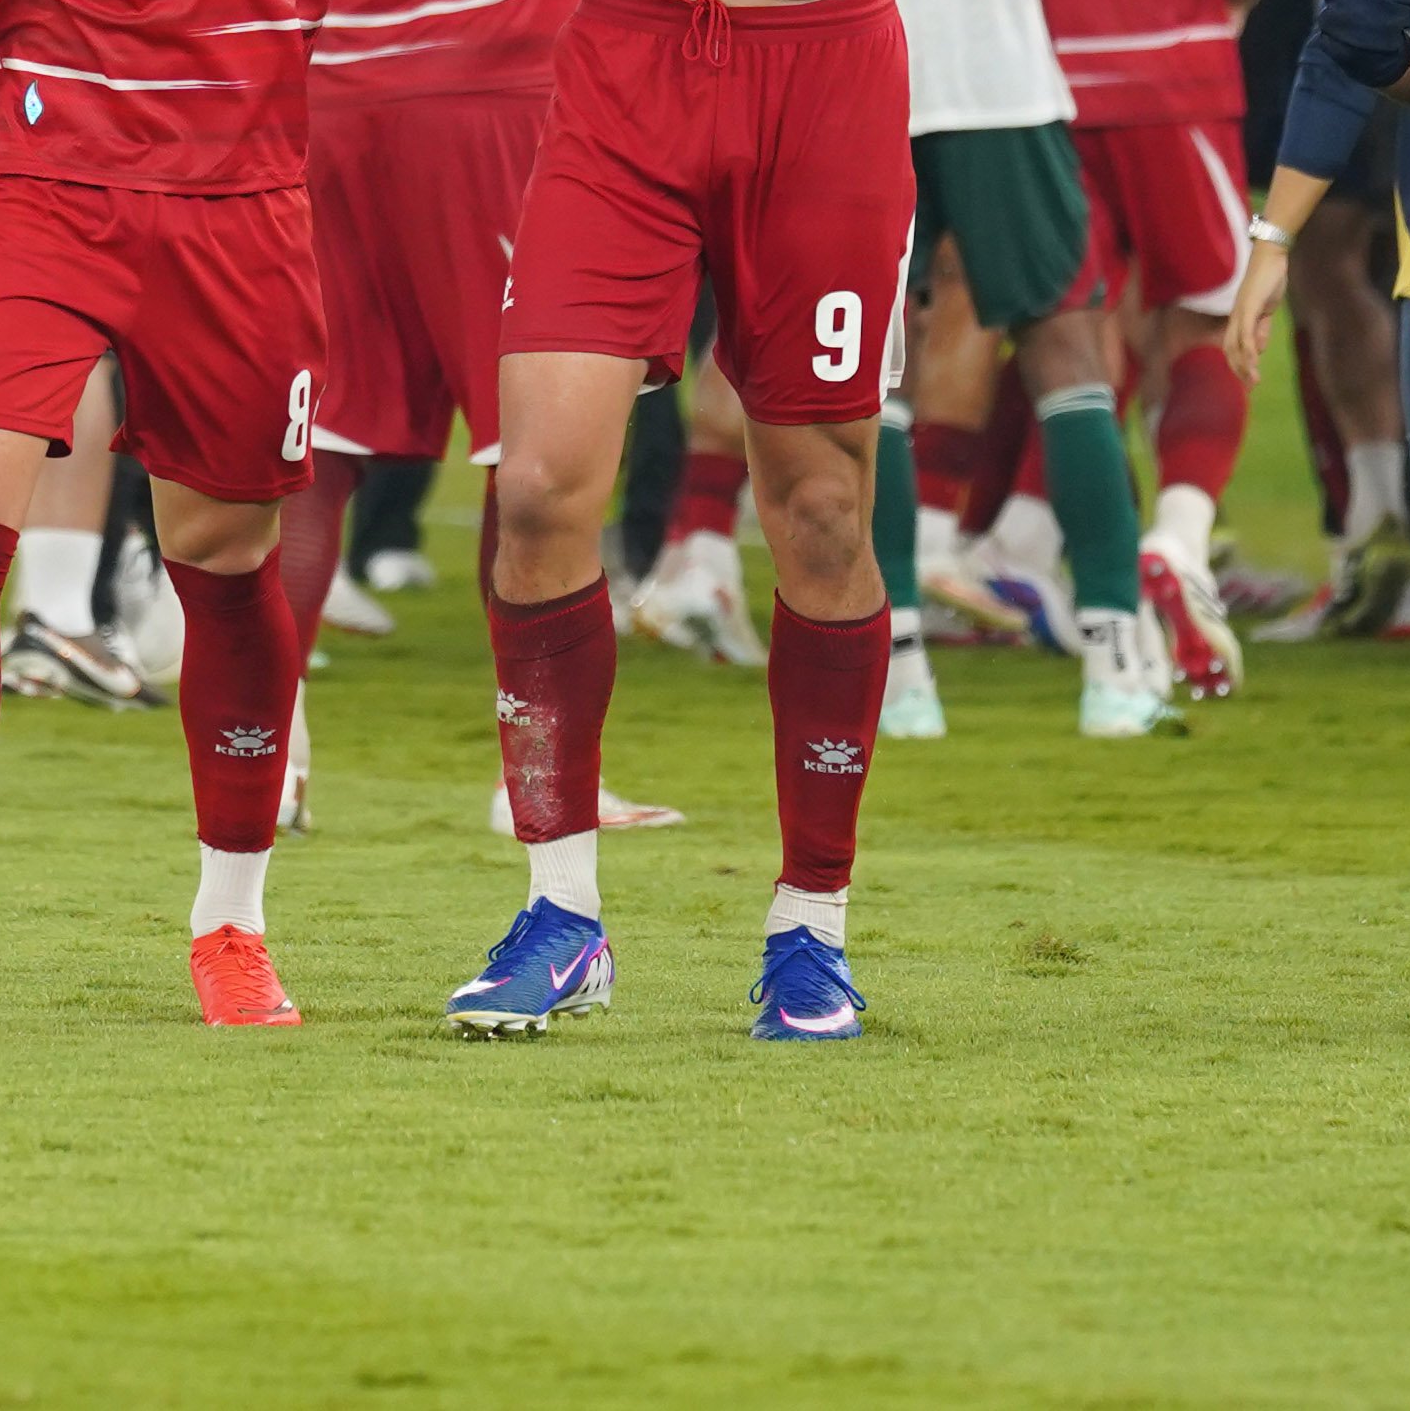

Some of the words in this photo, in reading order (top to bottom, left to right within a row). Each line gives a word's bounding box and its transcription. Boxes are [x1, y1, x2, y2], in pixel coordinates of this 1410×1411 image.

[812, 290, 863, 382] 9
[281, 369, 312, 462] 8
[215, 743, 277, 758] KELME
[804, 759, 864, 775] KELME
